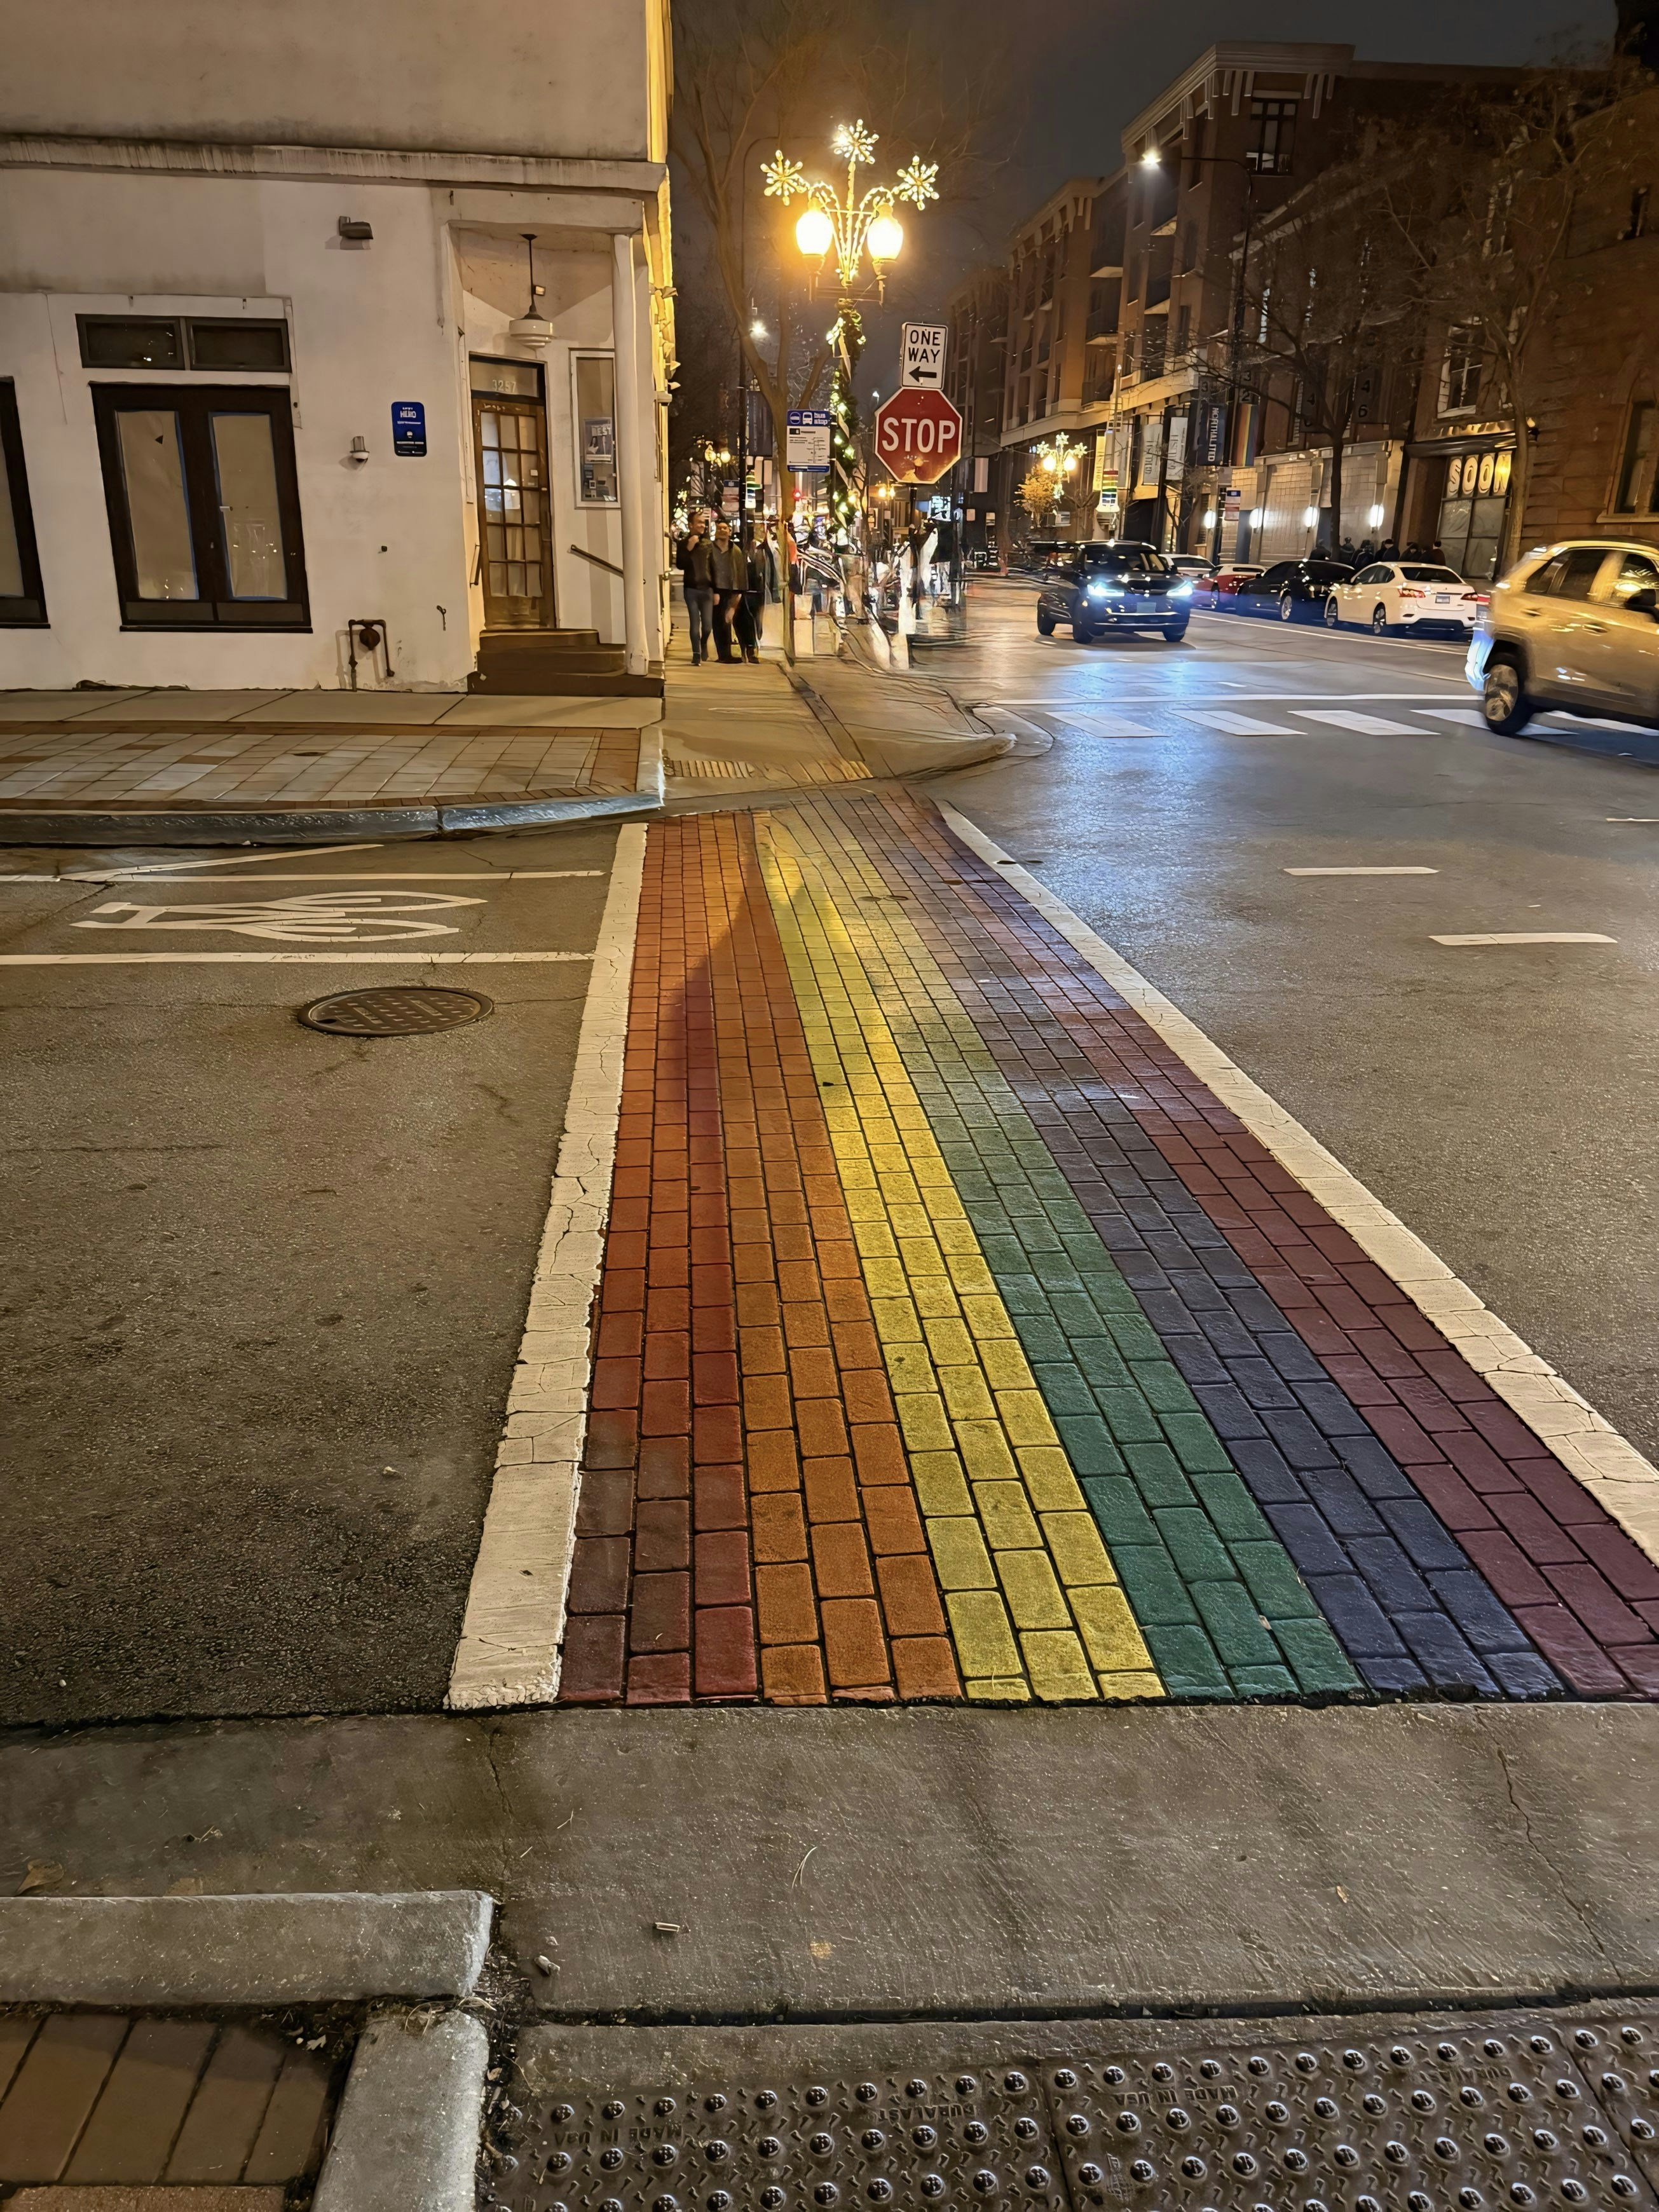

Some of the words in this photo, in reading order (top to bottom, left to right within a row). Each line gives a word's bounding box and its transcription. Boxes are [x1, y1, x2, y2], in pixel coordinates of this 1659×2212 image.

[910, 329, 941, 346] ONE
[908, 346, 941, 364] WAY
[882, 416, 957, 454] STOP
[1447, 453, 1512, 495] SOON
[1112, 2091, 1151, 2108] USA
[1156, 2088, 1179, 2105] IN
[1184, 2085, 1238, 2101] MADE
[554, 2131, 592, 2147] USA
[600, 2128, 619, 2146] IN
[629, 2127, 685, 2145] MADE
